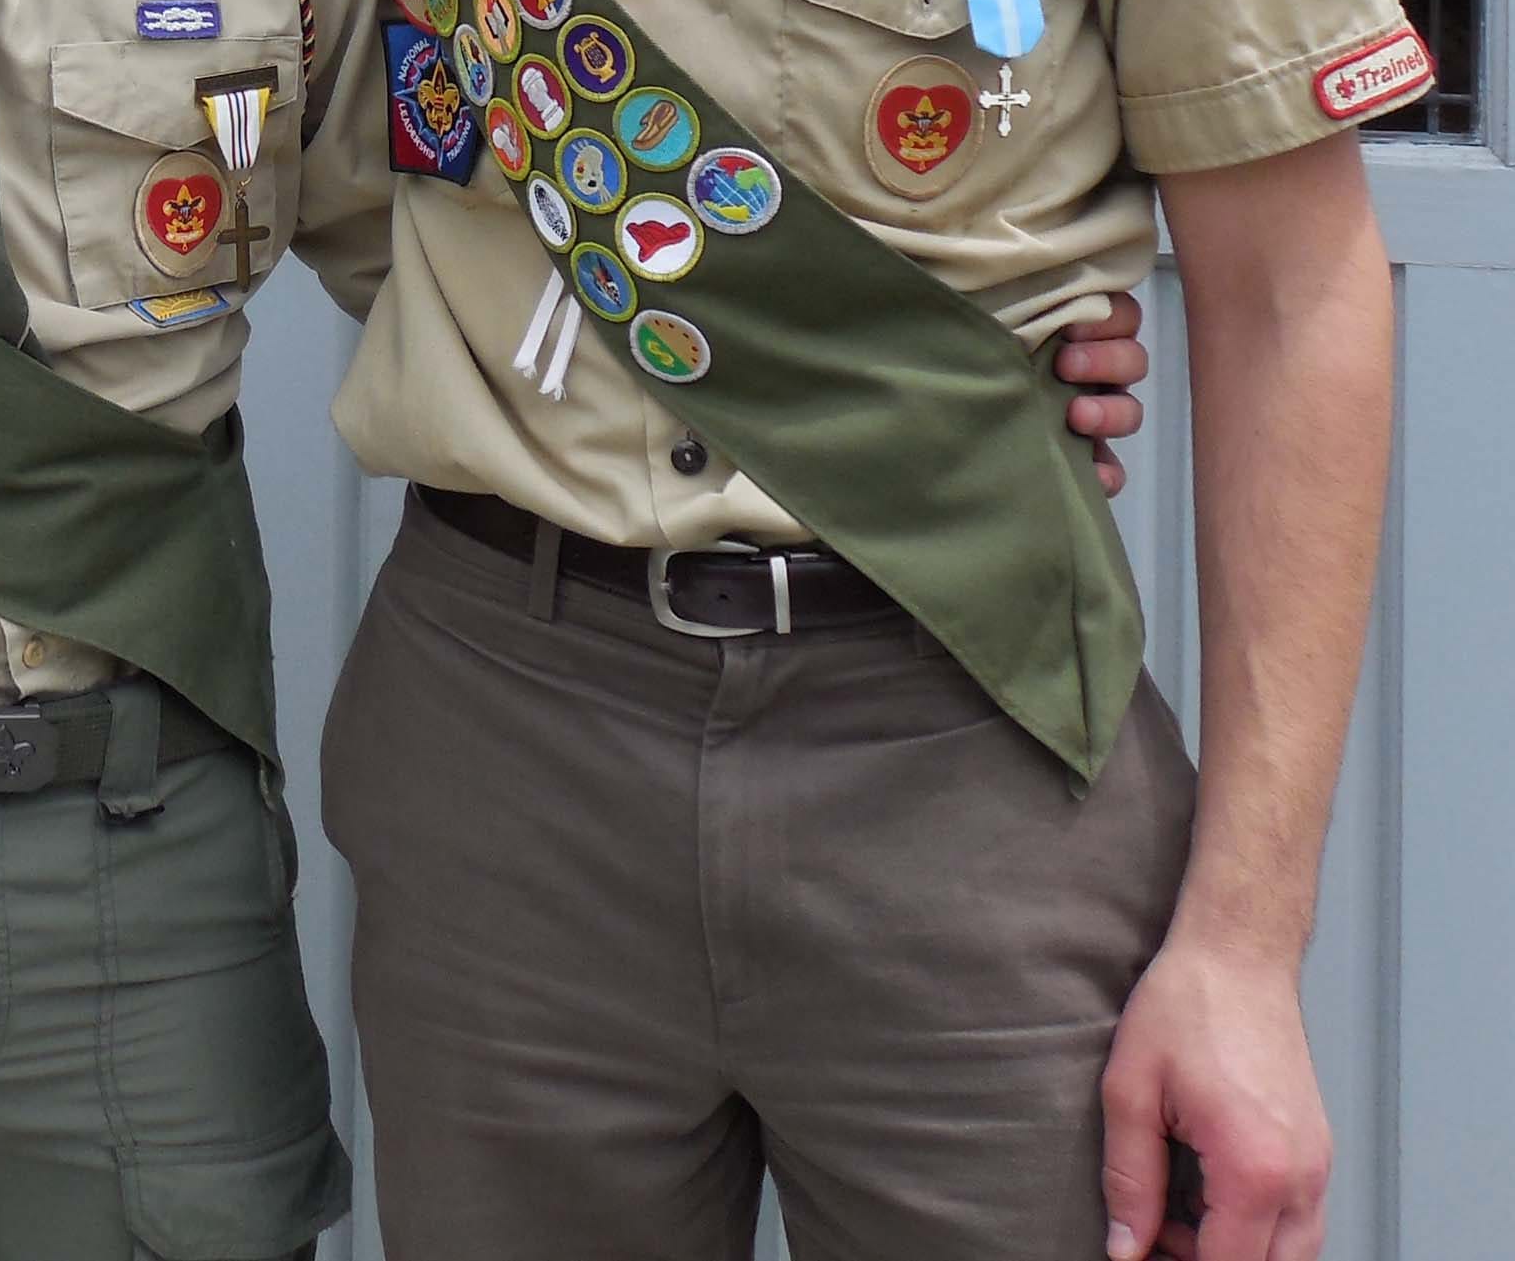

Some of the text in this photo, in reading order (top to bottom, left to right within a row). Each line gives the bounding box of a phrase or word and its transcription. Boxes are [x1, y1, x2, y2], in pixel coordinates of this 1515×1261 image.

[398, 38, 430, 80] NATIONAL
[1355, 45, 1425, 91] Trained
[397, 102, 436, 161] LEADERSHIP
[446, 119, 472, 164] TRAINING
